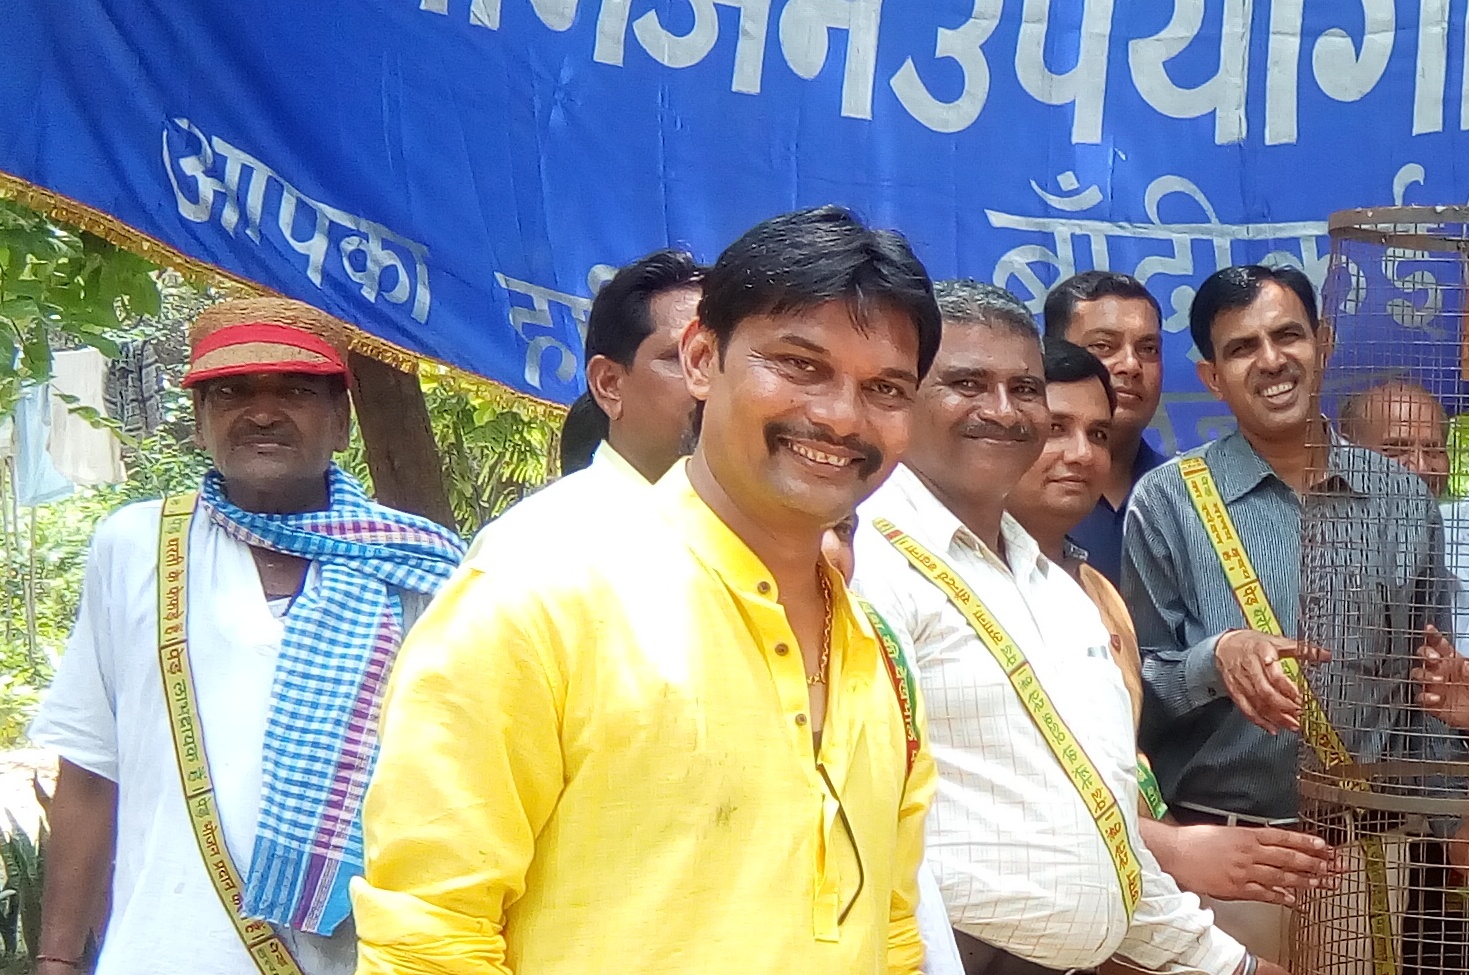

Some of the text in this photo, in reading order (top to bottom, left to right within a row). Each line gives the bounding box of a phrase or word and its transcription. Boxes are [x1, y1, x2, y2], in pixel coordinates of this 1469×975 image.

[162, 117, 430, 325] आपका
[1239, 583, 1261, 609] पेड़
[164, 646, 186, 676] पेड़
[1024, 687, 1047, 714] देते
[170, 679, 201, 764] लाभदायक
[1058, 742, 1080, 767] को
[1070, 761, 1098, 792] नेत्रों
[1086, 785, 1111, 813] पेड़
[200, 818, 221, 858] भोजन
[212, 858, 237, 892] प्रदान
